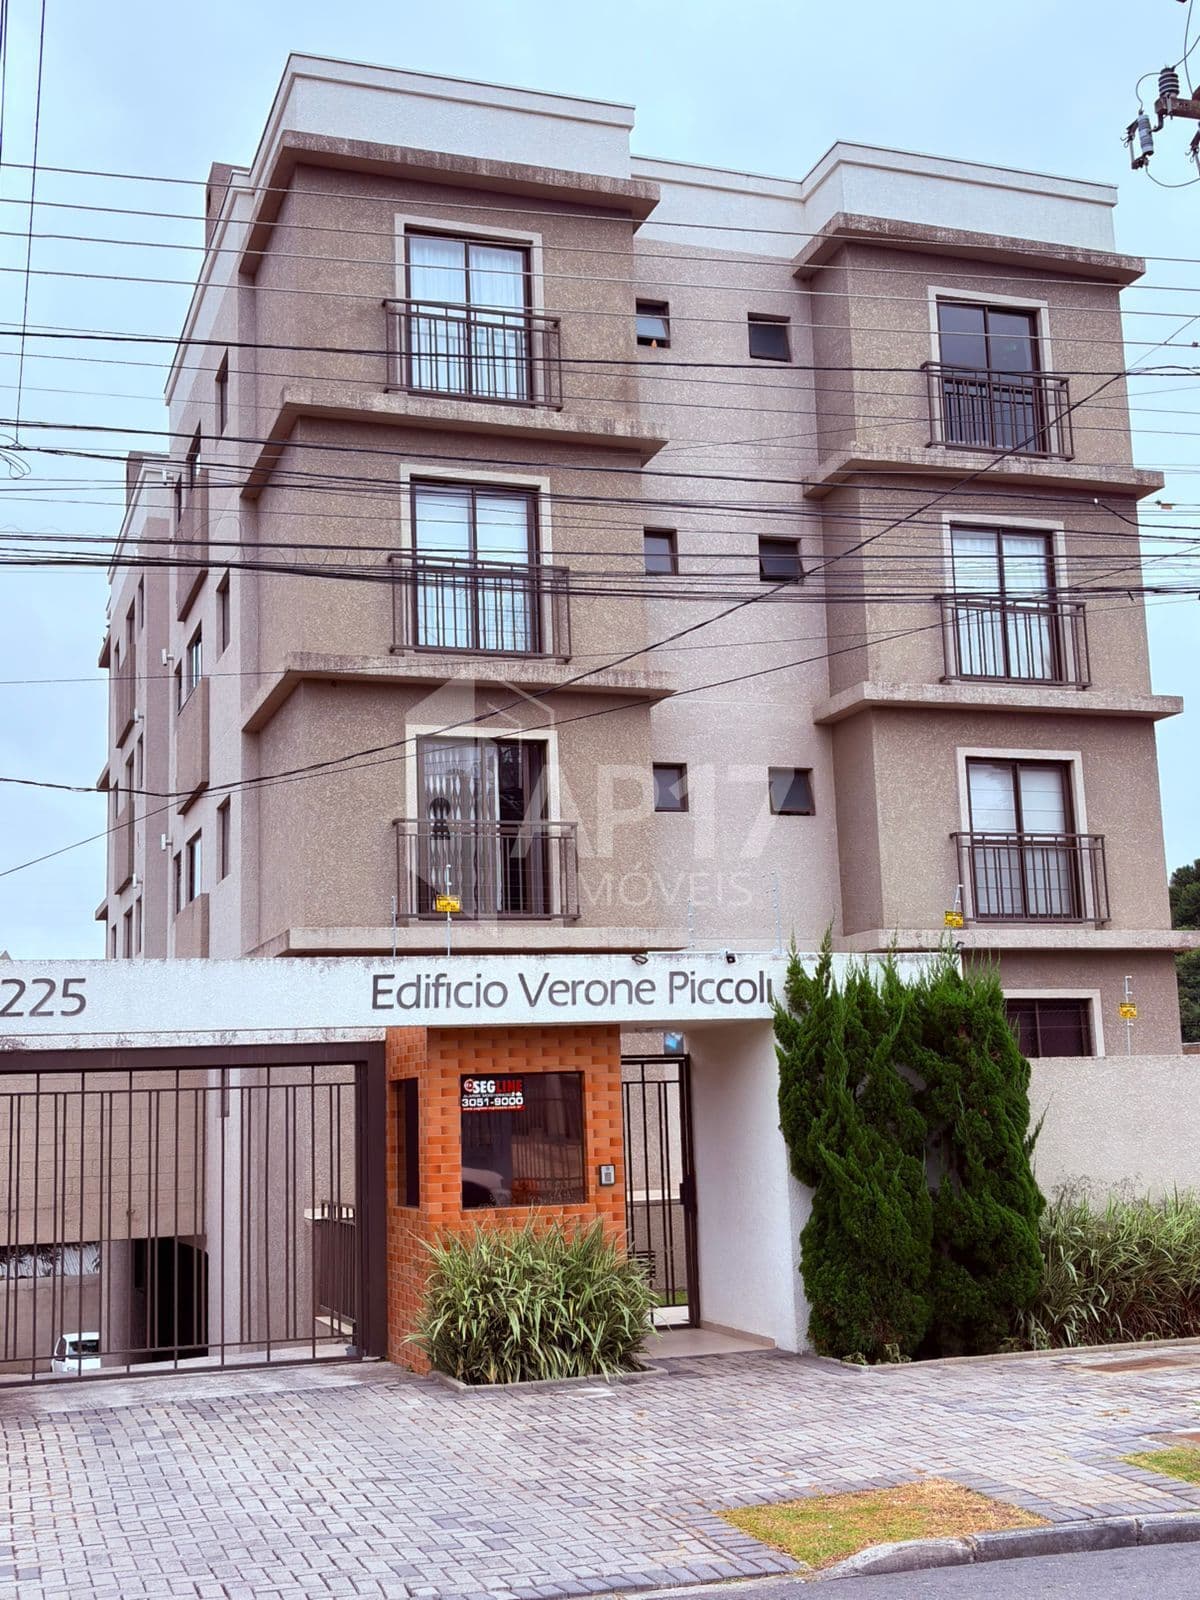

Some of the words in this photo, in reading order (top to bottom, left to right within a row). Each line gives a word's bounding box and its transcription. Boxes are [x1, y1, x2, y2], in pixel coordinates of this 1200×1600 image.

[0, 977, 87, 1017] 225
[371, 973, 509, 1010] Edificio
[518, 972, 657, 1007] Verone
